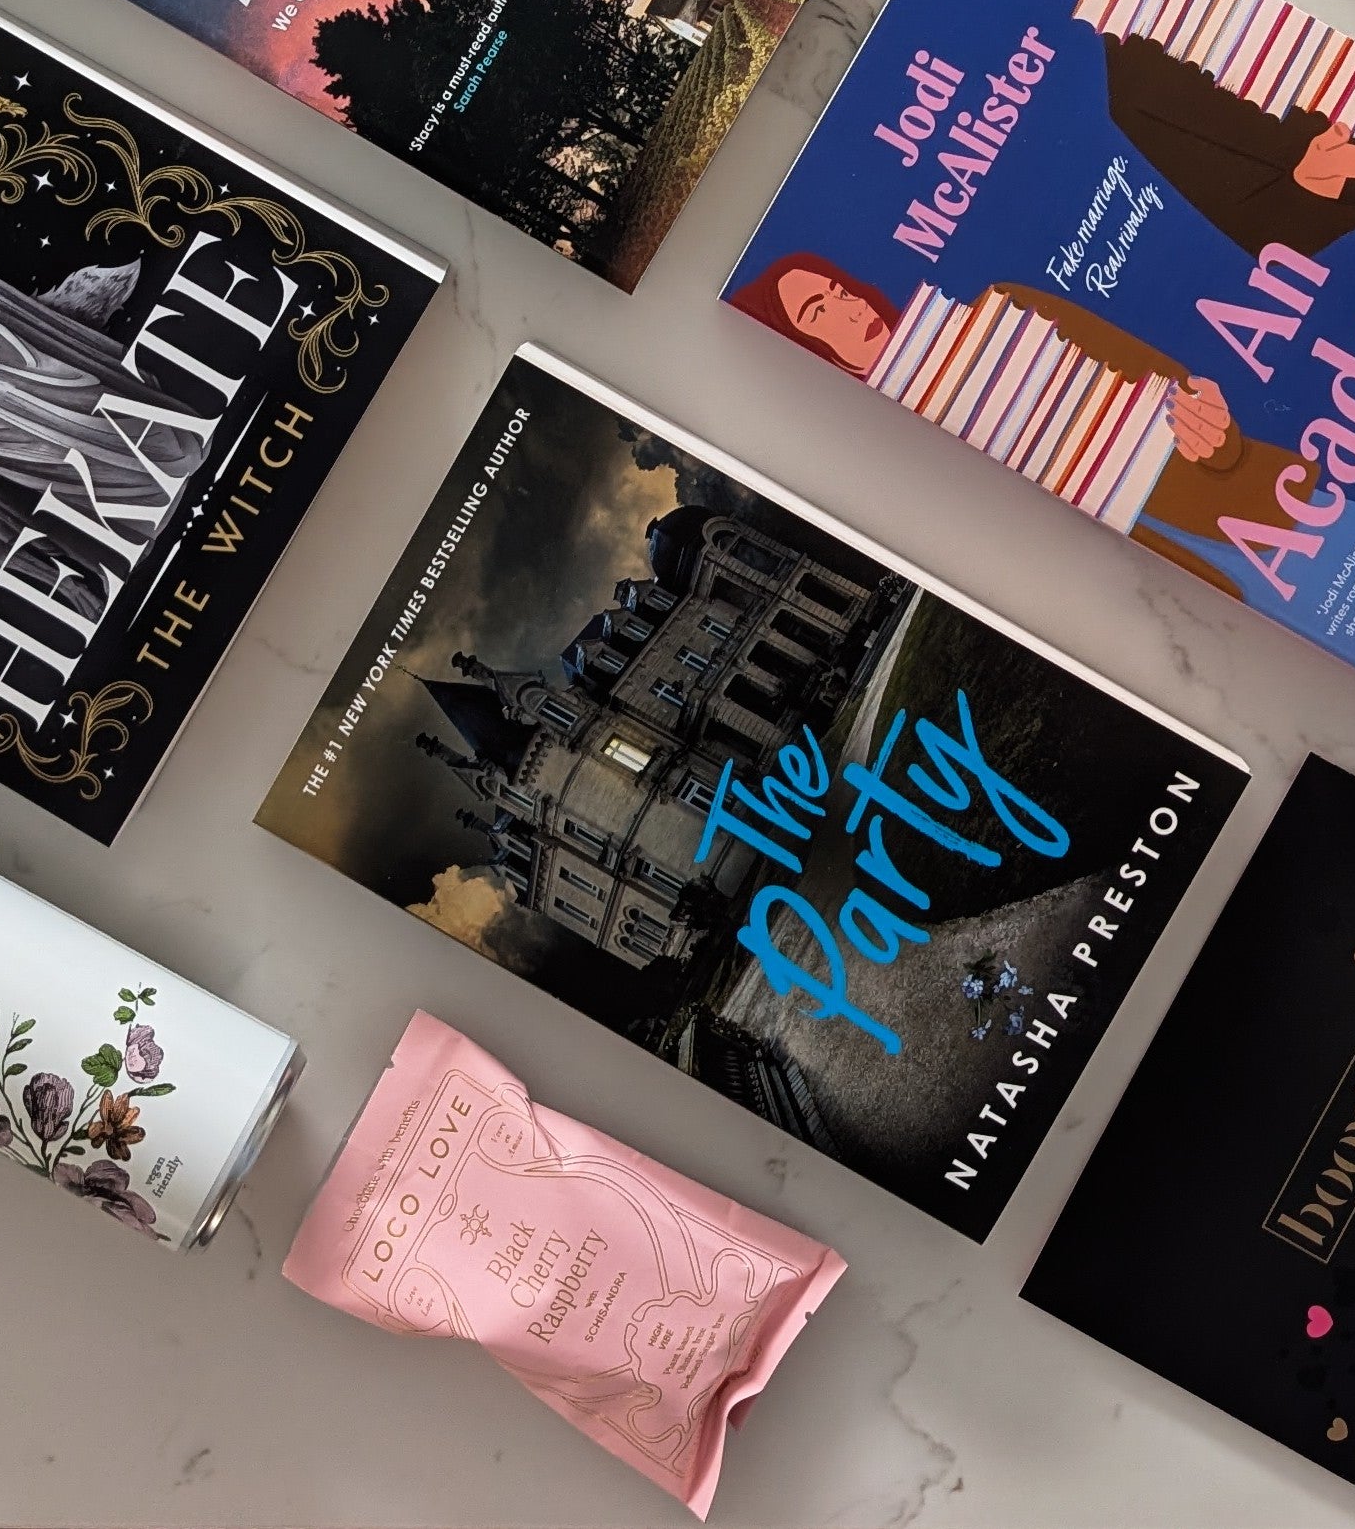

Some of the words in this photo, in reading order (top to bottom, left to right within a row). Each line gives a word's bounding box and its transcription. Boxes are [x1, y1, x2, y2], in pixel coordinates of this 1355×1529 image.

[271, 4, 298, 31] We
[431, 101, 446, 114] is
[442, 89, 453, 101] a
[448, 21, 492, 90] must-read
[450, 70, 483, 113] Sarah
[475, 27, 510, 74] Pearse
[873, 50, 965, 167] Jodi
[892, 26, 1056, 263] McAlister
[1045, 239, 1085, 292] Fake
[1077, 155, 1133, 244] marriage.
[1085, 242, 1127, 299] Real
[1118, 182, 1164, 251] rivalry.
[1195, 242, 1331, 383] An
[136, 579, 211, 670] THE
[200, 402, 314, 553] WITCH
[302, 763, 330, 796] THE
[323, 740, 343, 763] #1
[338, 693, 367, 737] NEW
[361, 642, 398, 692] YORK
[390, 589, 427, 642] TIMES
[420, 482, 488, 590] BESTSELLING
[483, 407, 531, 480] AUTHOR
[694, 727, 830, 873] The
[736, 690, 1071, 1055] Party
[944, 992, 1078, 1191] NATASHA
[1072, 770, 1201, 968] PRESTON
[144, 1154, 168, 1188] vegan
[152, 1153, 184, 1198] friendly
[361, 1190, 423, 1282] LOCO
[417, 1094, 473, 1179] LOVE
[485, 1215, 537, 1284] Black
[508, 1226, 574, 1312] Cherry
[526, 1225, 612, 1346] Raspberry
[583, 1270, 629, 1343] SCHISANDRA
